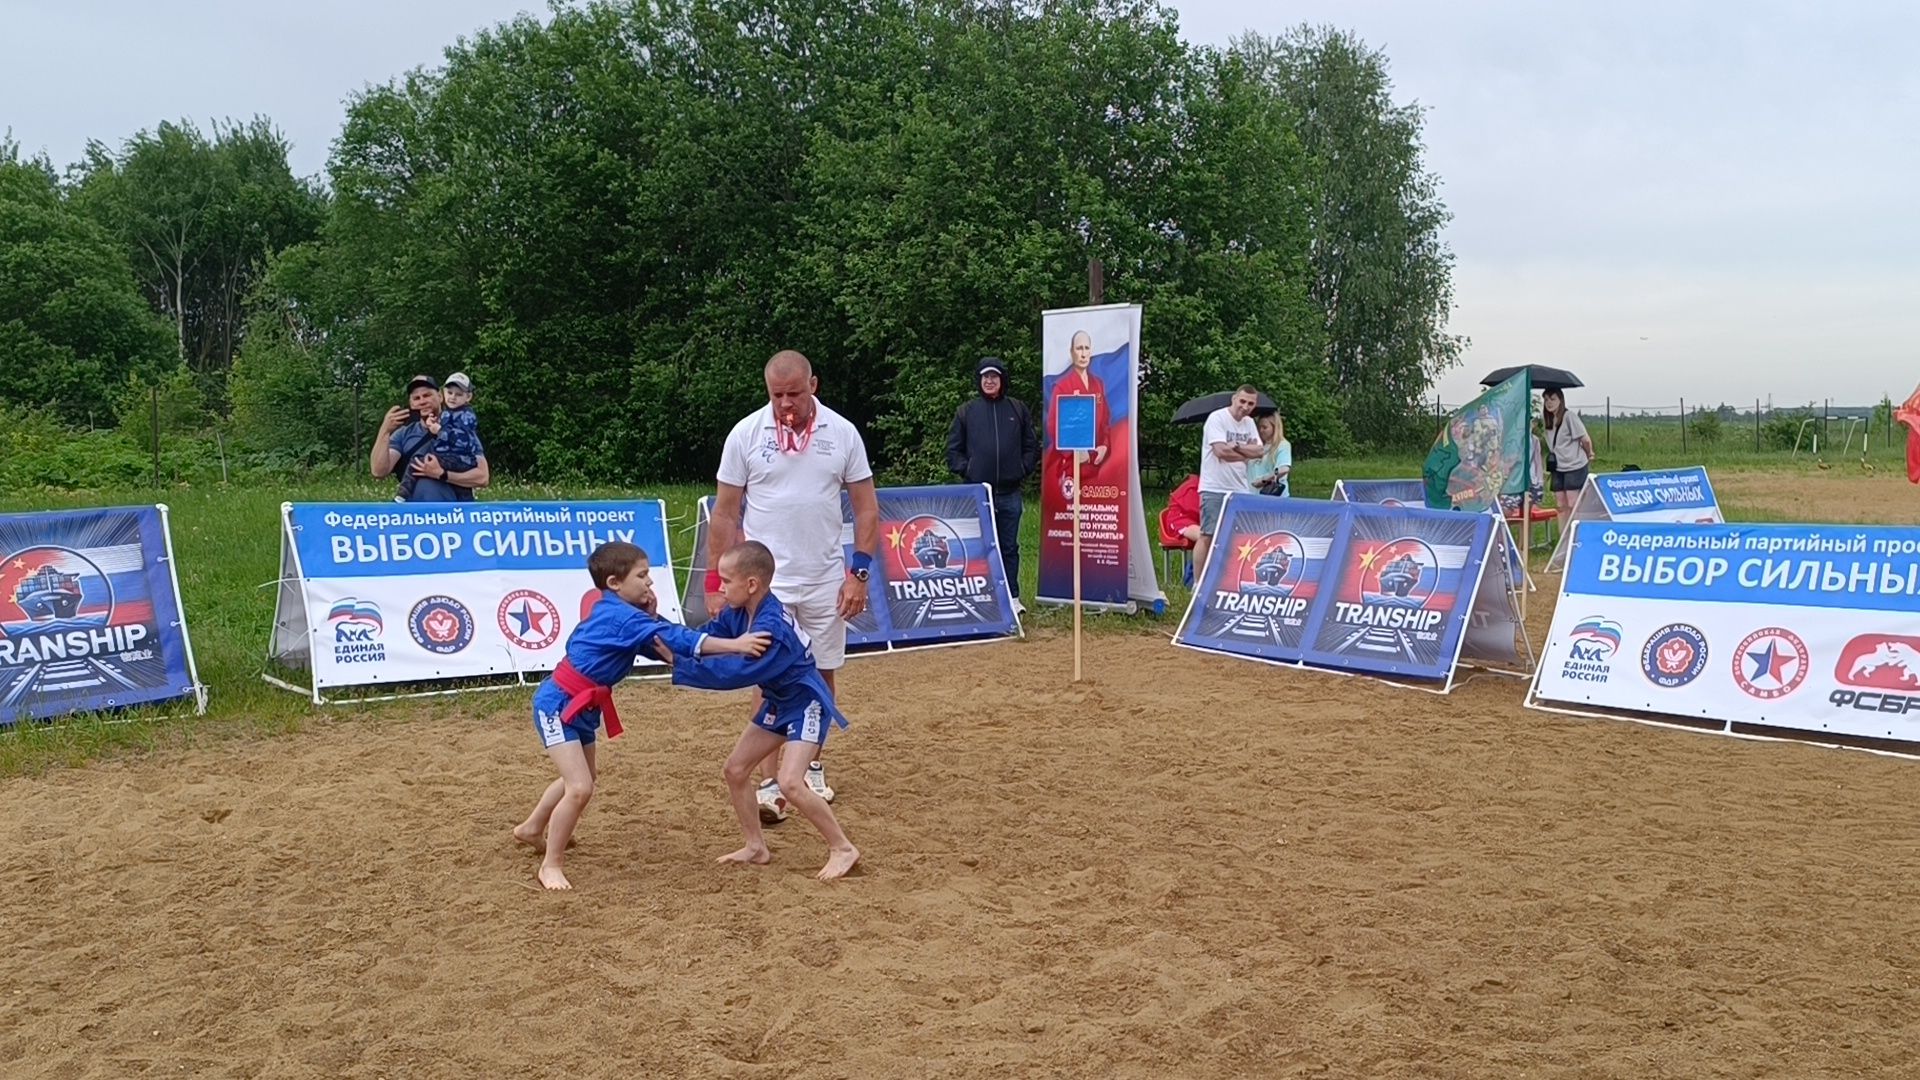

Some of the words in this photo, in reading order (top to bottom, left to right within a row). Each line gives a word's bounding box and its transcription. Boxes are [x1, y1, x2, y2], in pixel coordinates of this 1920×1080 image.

[1081, 485, 1118, 498] САМБО
[1612, 490, 1653, 507] ВЫБОР
[1654, 486, 1704, 502] СИЛЬНЫХ
[1054, 512, 1089, 520] ДОСТОИЕ
[1067, 504, 1118, 513] НАИОНАЛЬНОЕ
[324, 508, 465, 529] Федеральный
[470, 506, 570, 526] партийный
[576, 511, 635, 526] проект
[1092, 523, 1117, 531] НУЖНО
[331, 532, 462, 564] ВЫБОР
[1602, 530, 1740, 551] Федеральный
[1745, 534, 1867, 554] партийный
[1598, 554, 1728, 587] ВЫБОР
[1737, 558, 1920, 595] СИЛЬНЫ
[890, 576, 987, 600] TRANSHIP
[1215, 591, 1307, 617] TRANSHIP
[430, 597, 461, 610] ДЗЮДО
[460, 608, 473, 642] РОССИИ
[1335, 601, 1442, 630] TRANSHIP
[334, 643, 385, 654] ЕДИНАЯ
[513, 636, 554, 649] САМБО
[1672, 625, 1702, 641] ДЗЮДО
[1691, 641, 1707, 676] РОССИИ
[336, 652, 385, 664] РОССИЯ
[1563, 661, 1610, 673] ЕДИНАЯ
[1562, 670, 1608, 683] РОССИЯ
[1658, 676, 1679, 685] ФДР
[1740, 681, 1791, 698] САМБО
